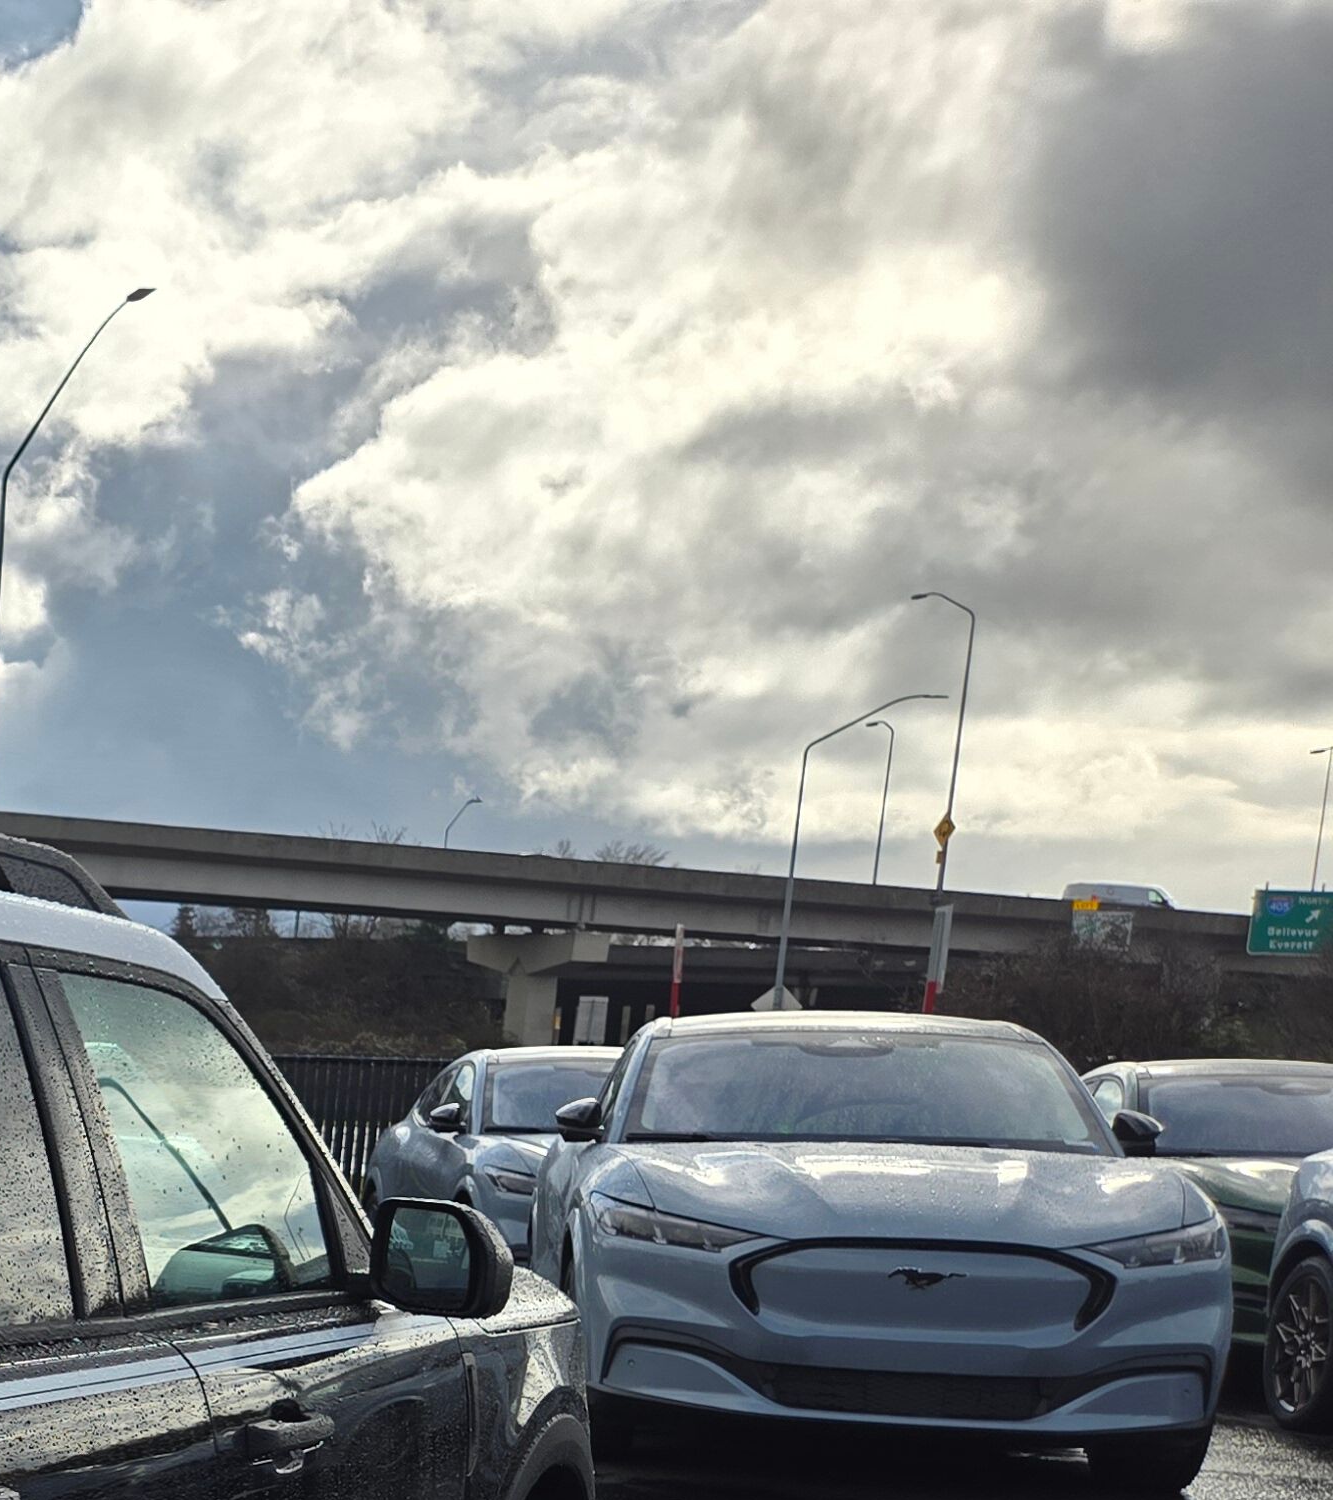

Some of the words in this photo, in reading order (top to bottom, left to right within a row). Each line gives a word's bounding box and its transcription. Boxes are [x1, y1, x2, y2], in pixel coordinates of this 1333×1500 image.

[1270, 902, 1290, 912] 405
[1267, 926, 1319, 937] Bellevue
[1269, 940, 1314, 950] Everett
